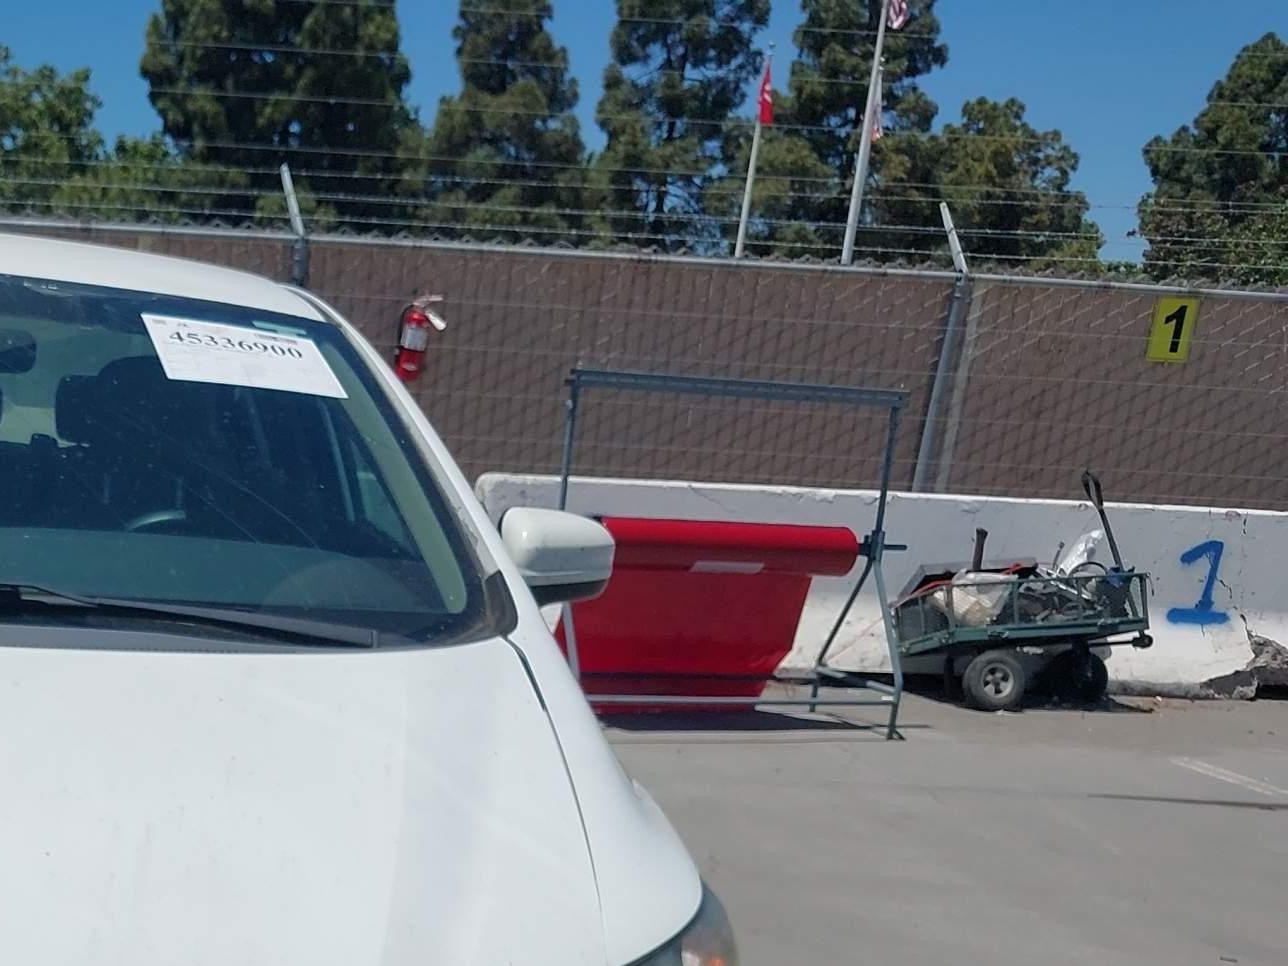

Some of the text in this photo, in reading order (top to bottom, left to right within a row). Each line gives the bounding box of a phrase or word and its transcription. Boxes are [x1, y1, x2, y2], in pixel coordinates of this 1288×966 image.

[169, 330, 303, 359] 45336900
[1164, 304, 1188, 353] 1
[1165, 539, 1230, 627] 1
